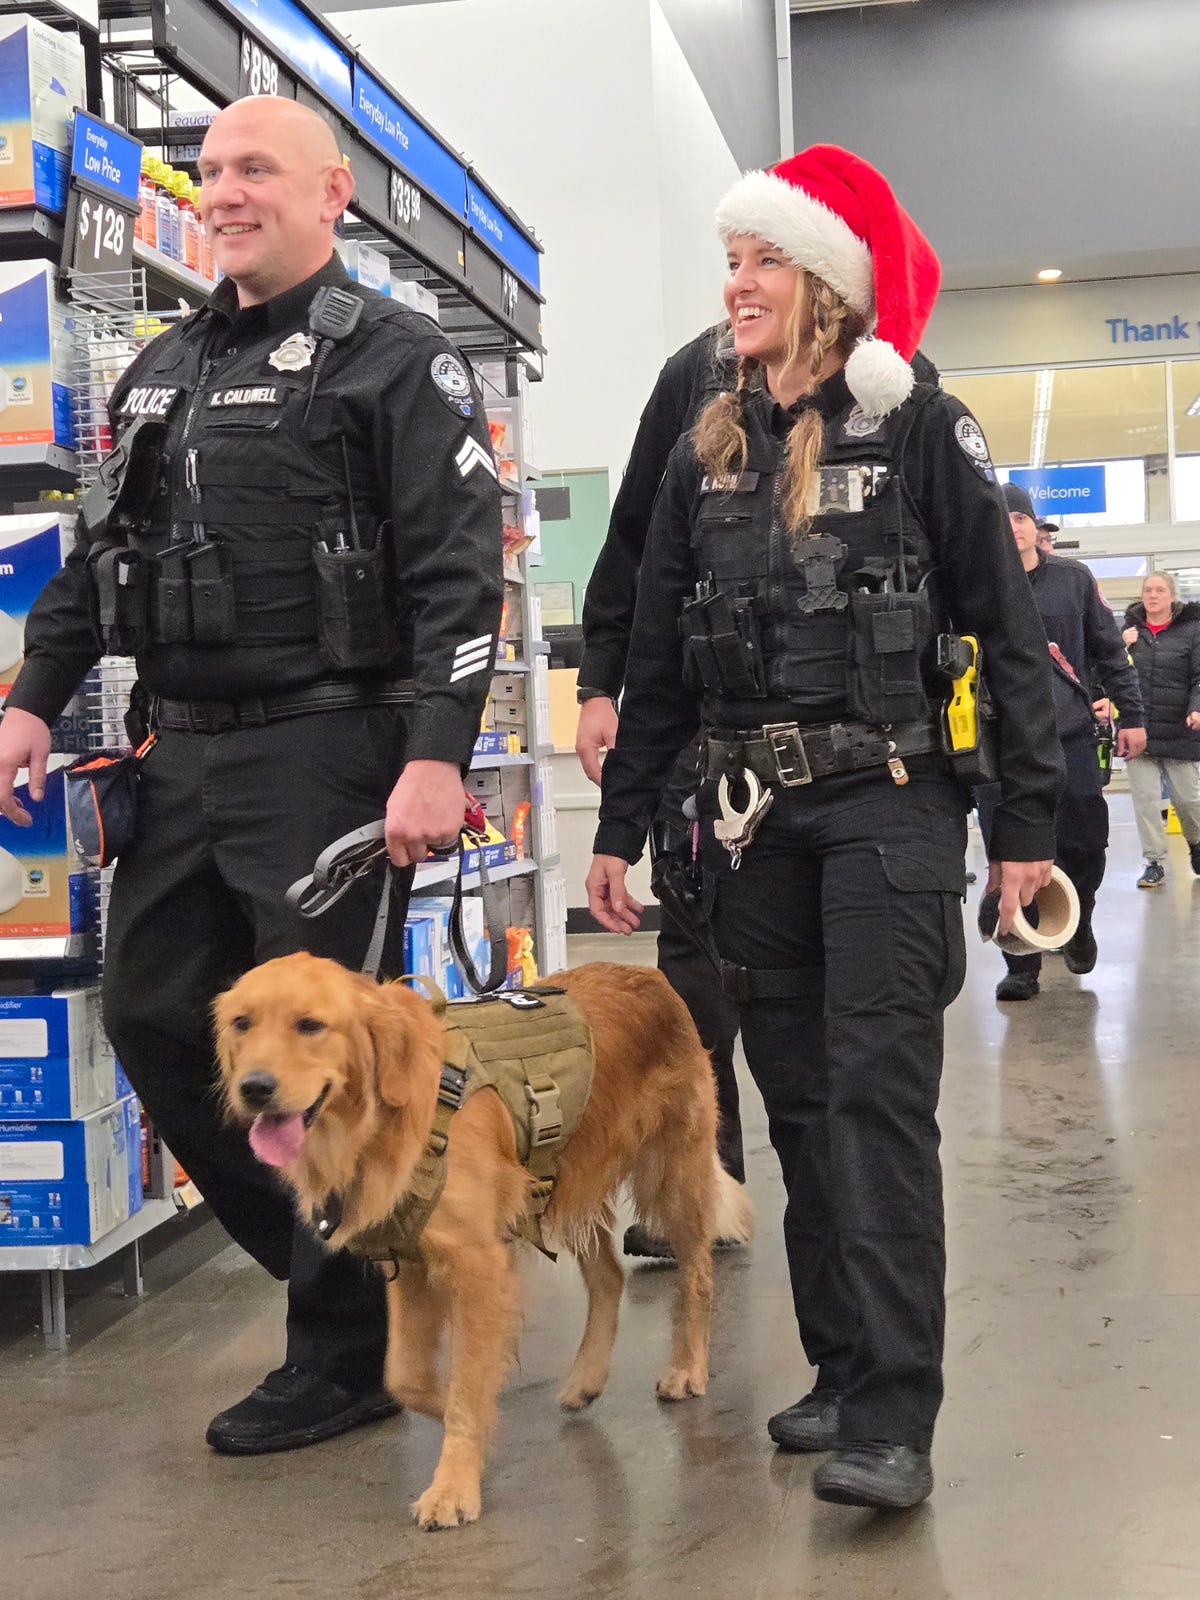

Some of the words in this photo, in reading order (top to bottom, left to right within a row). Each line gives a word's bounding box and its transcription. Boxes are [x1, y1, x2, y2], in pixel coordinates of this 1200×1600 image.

[359, 87, 385, 133] Everyday
[385, 111, 397, 139] Low
[396, 121, 409, 150] Price
[86, 127, 108, 152] Everyday
[84, 147, 101, 174] Low
[101, 156, 121, 184] Price
[1105, 315, 1190, 343] Thank
[121, 387, 176, 415] POLICE
[224, 387, 277, 404] CALDWELL
